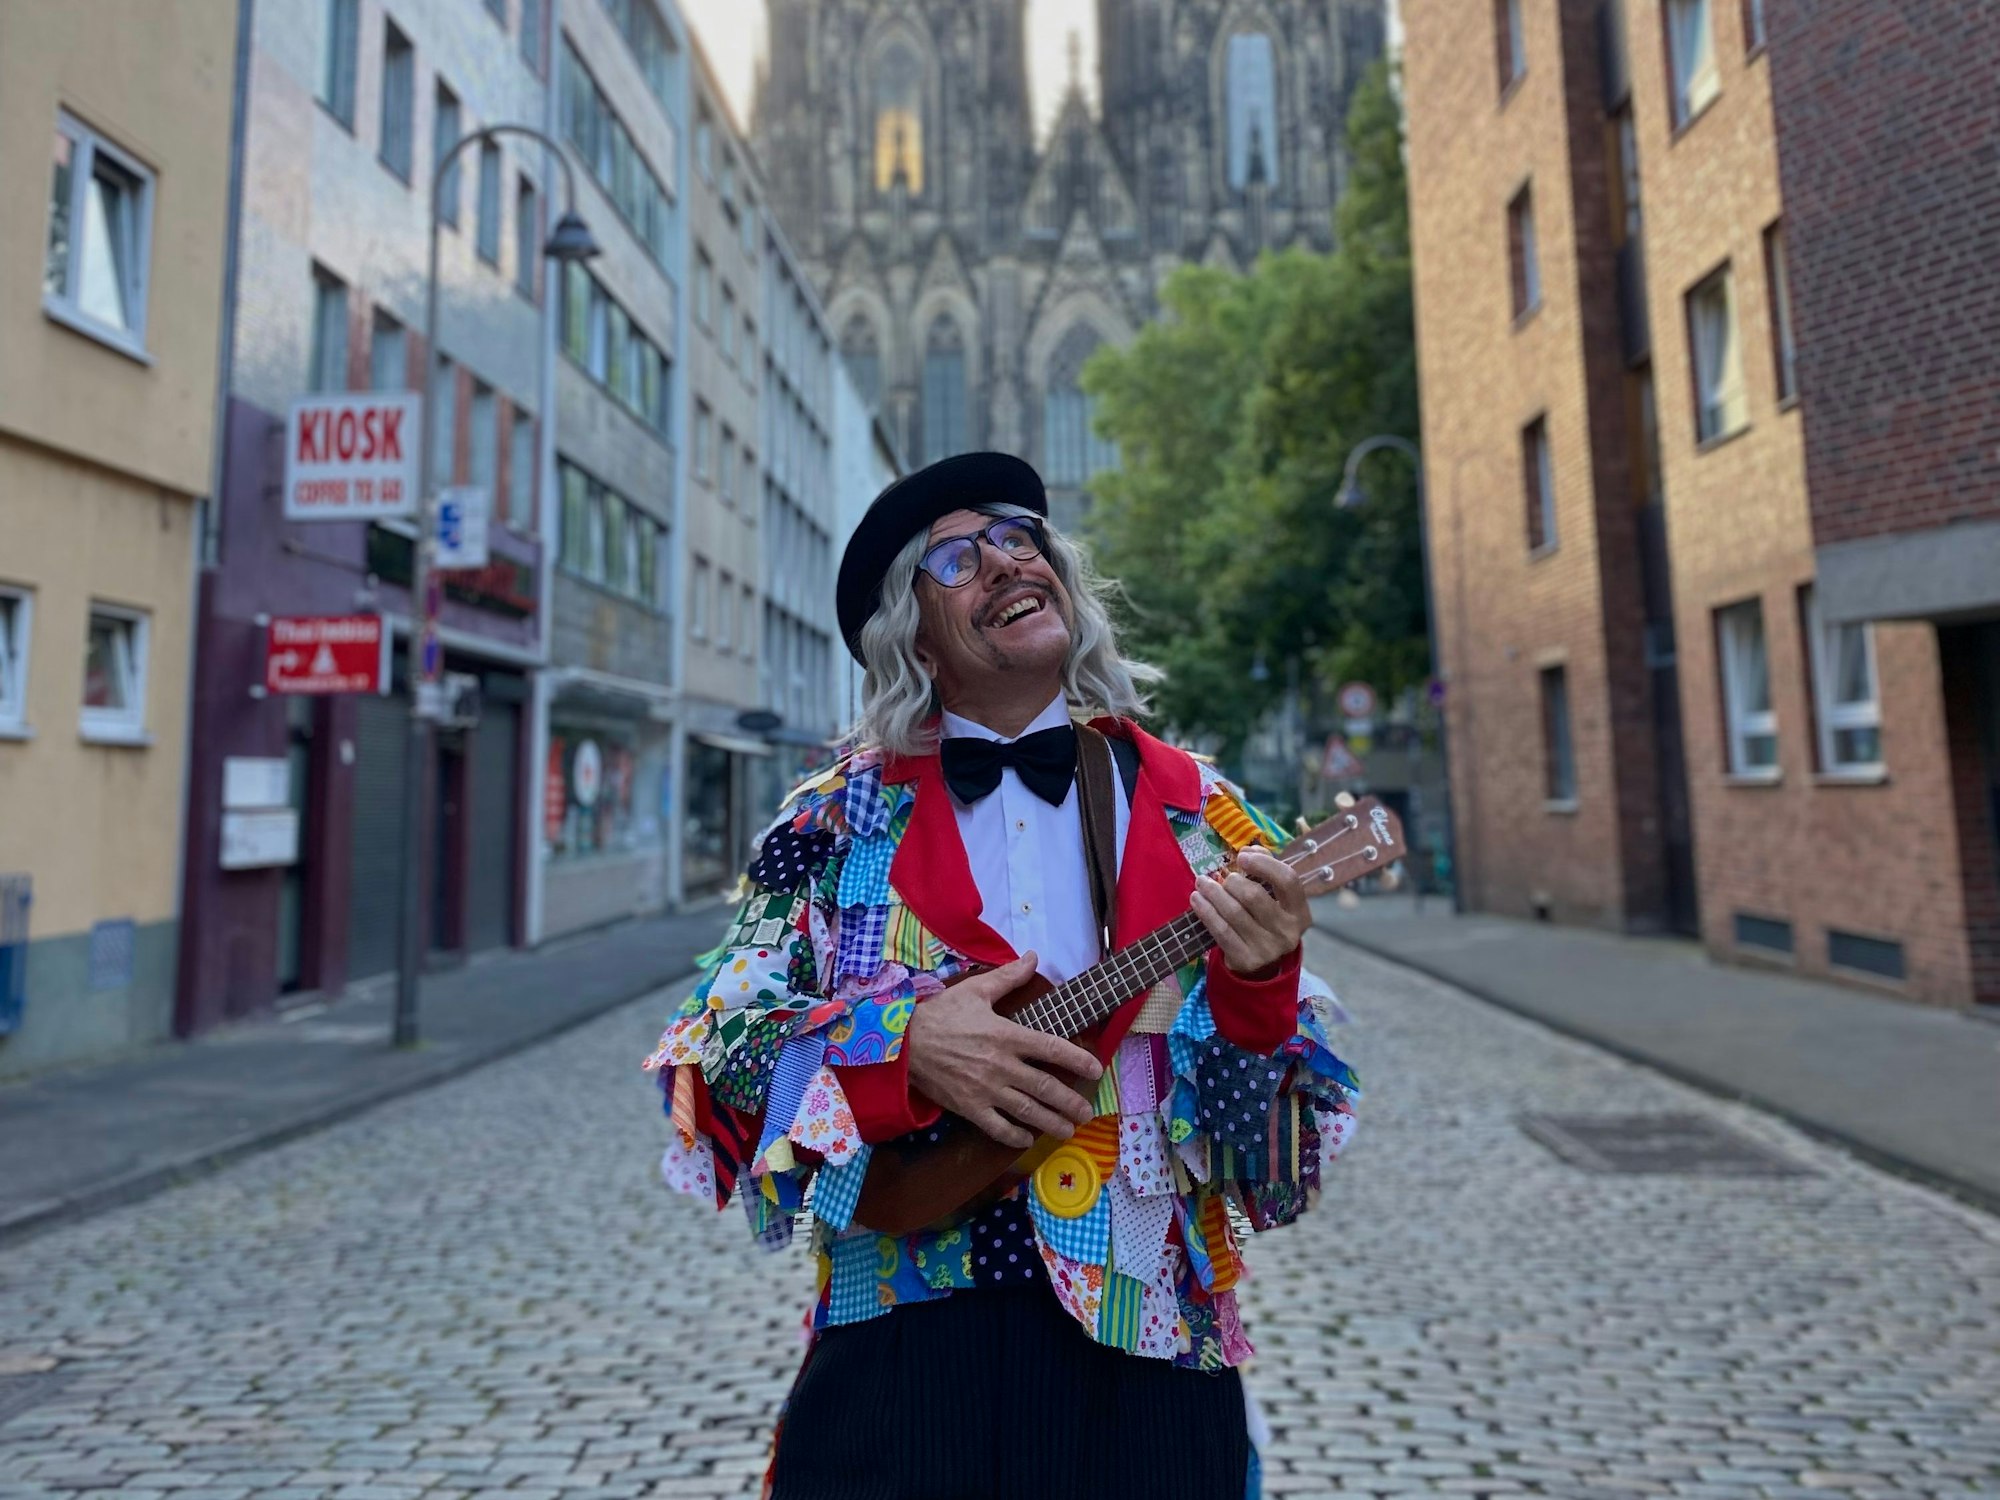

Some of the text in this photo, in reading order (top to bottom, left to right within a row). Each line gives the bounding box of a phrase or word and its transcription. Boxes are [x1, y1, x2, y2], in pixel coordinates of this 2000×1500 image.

[297, 406, 404, 463] KIOSK
[295, 479, 348, 504] COFFEE
[355, 479, 373, 502] TO
